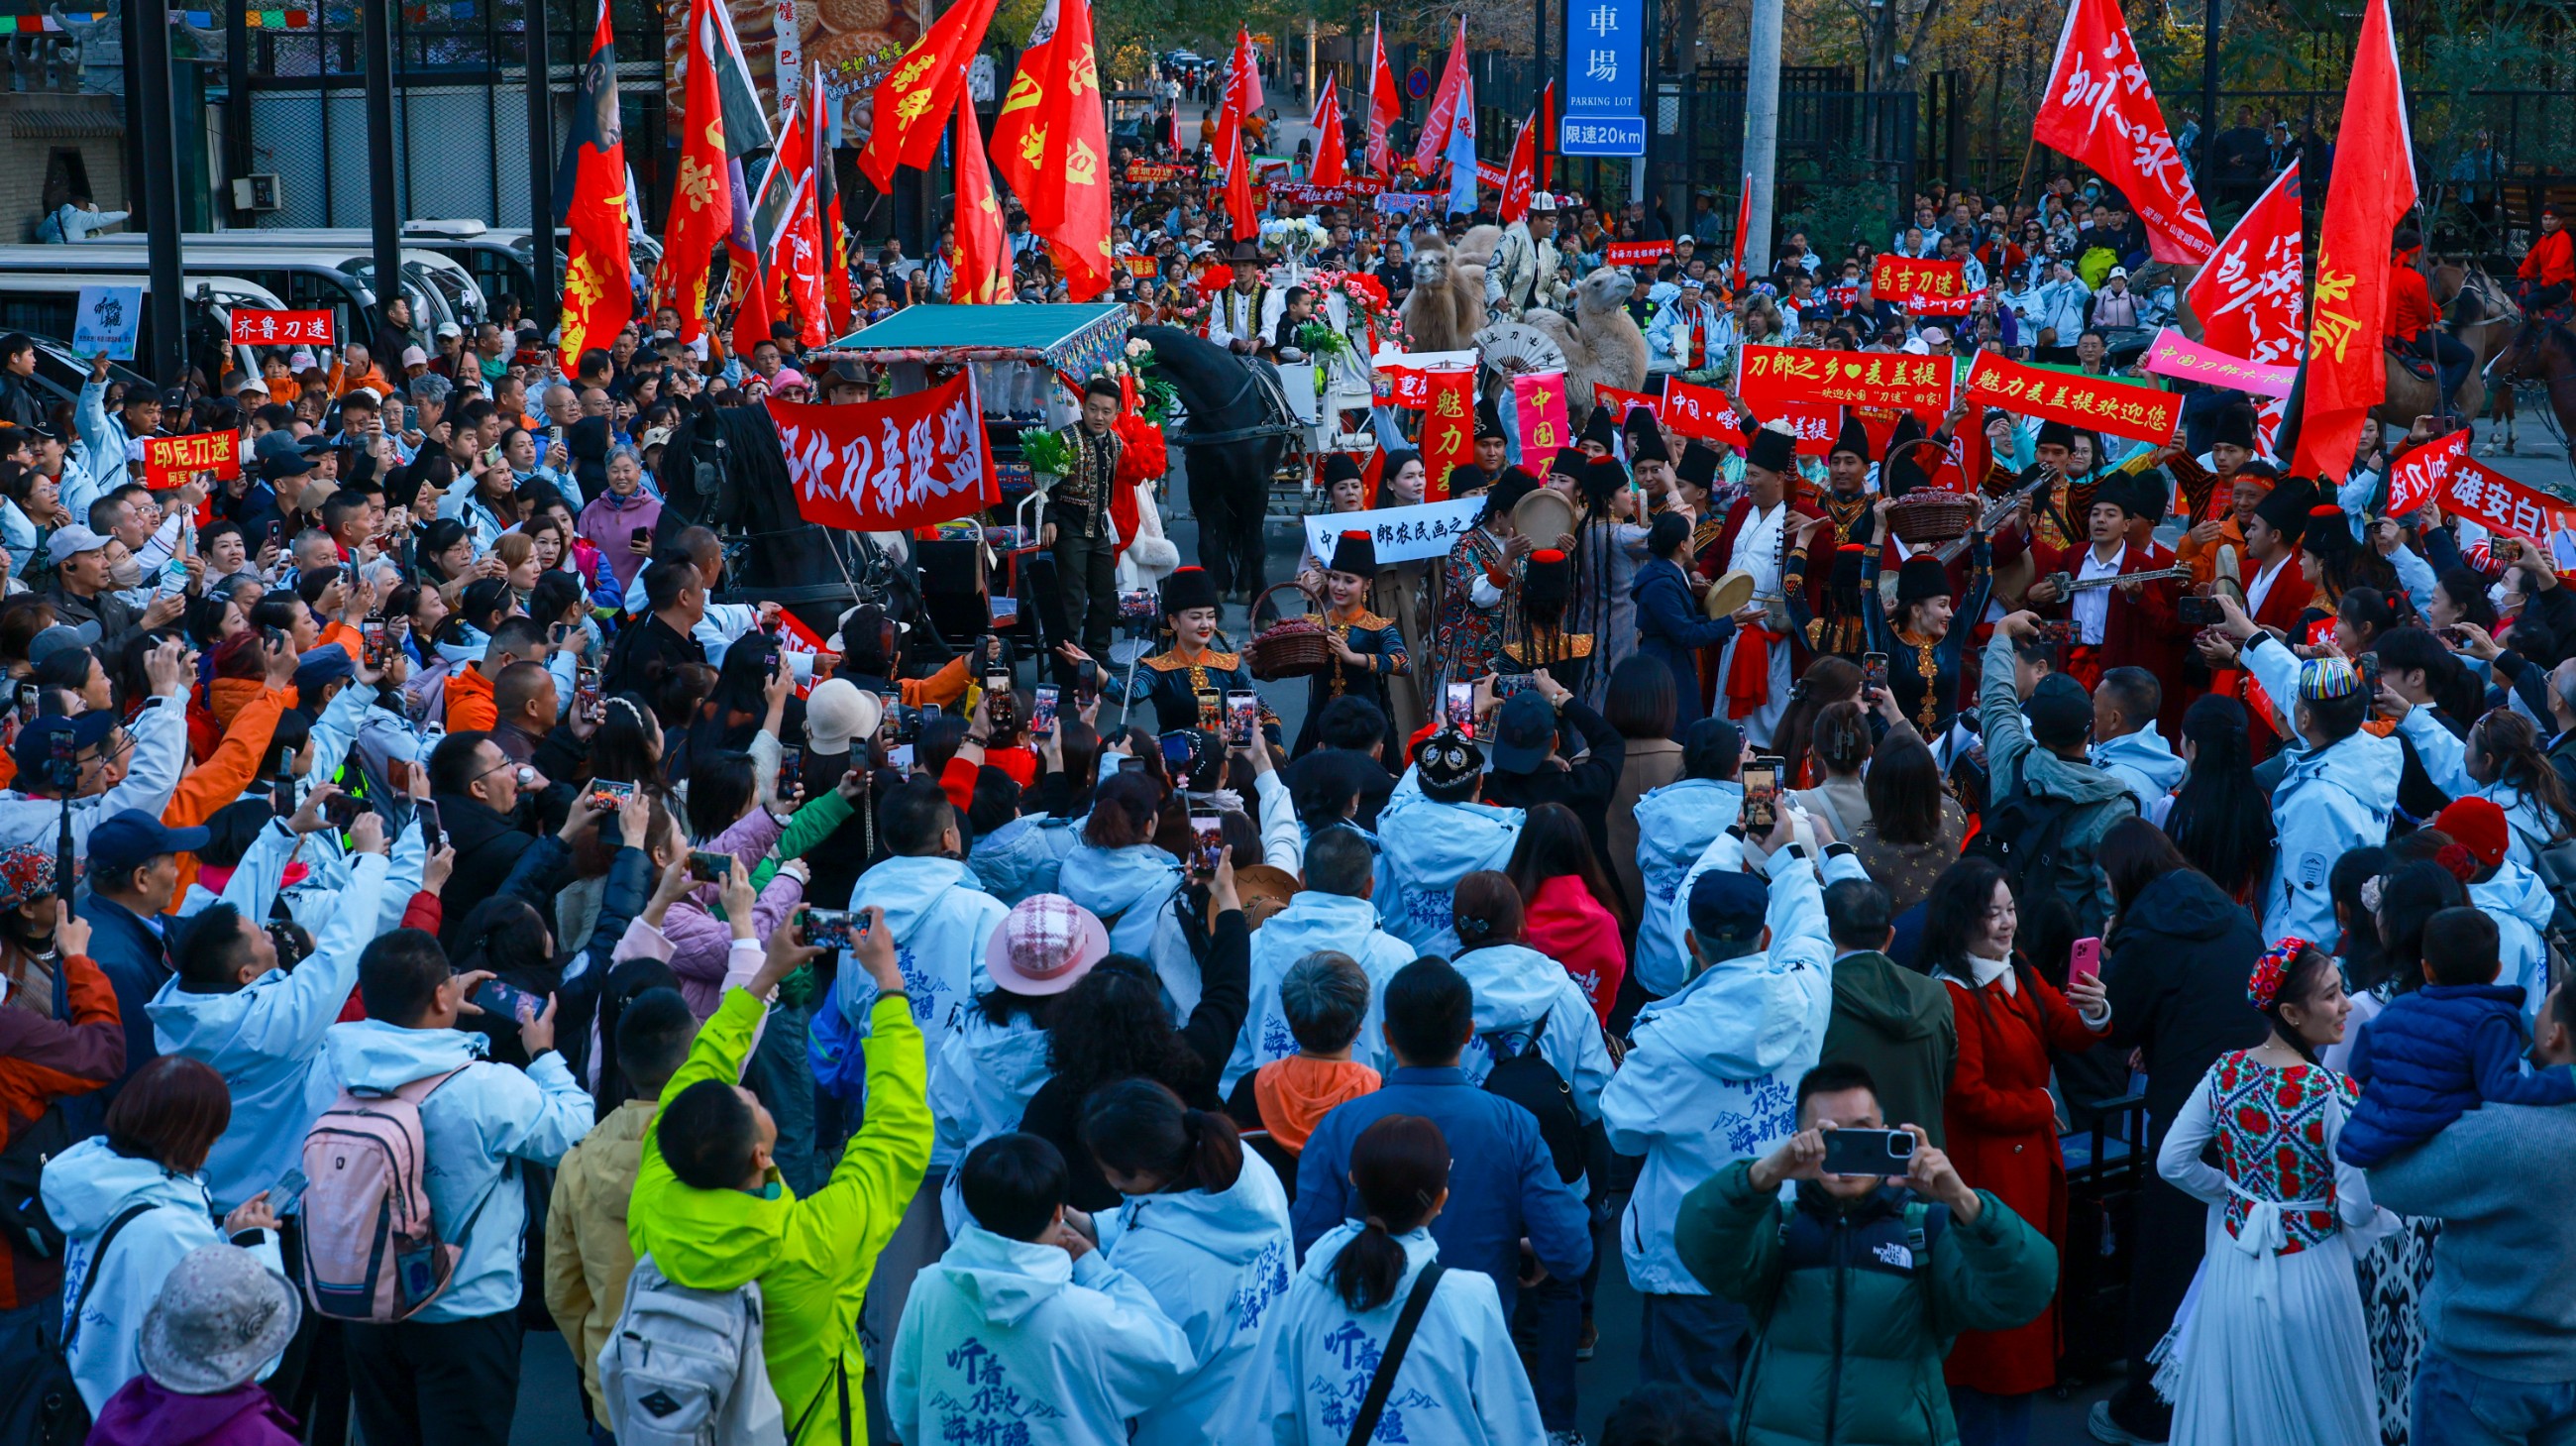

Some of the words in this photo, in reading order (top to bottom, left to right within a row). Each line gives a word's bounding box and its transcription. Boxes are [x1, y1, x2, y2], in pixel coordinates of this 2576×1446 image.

[1586, 5, 1619, 82] 車場
[1571, 97, 1610, 106] PARKING
[1615, 97, 1633, 106] LOT
[1565, 126, 1641, 144] 限速20km
[1878, 265, 1955, 296] 昌吉刀迷
[235, 315, 329, 340] 齐鲁刀迷
[1748, 351, 1839, 384] 刀郎之乡
[1865, 358, 1942, 388] 麦盖提
[1978, 368, 2168, 432] 魅力麦盖提欢迎您
[154, 433, 230, 468] 印尼刀迷
[2450, 467, 2549, 544] 雄安白
[1874, 1247, 1900, 1259] NORTH
[1879, 1255, 1900, 1265] FACE
[1886, 1242, 1901, 1252] THE
[946, 1337, 1006, 1386] 听着
[971, 1387, 1020, 1417] 刀歌
